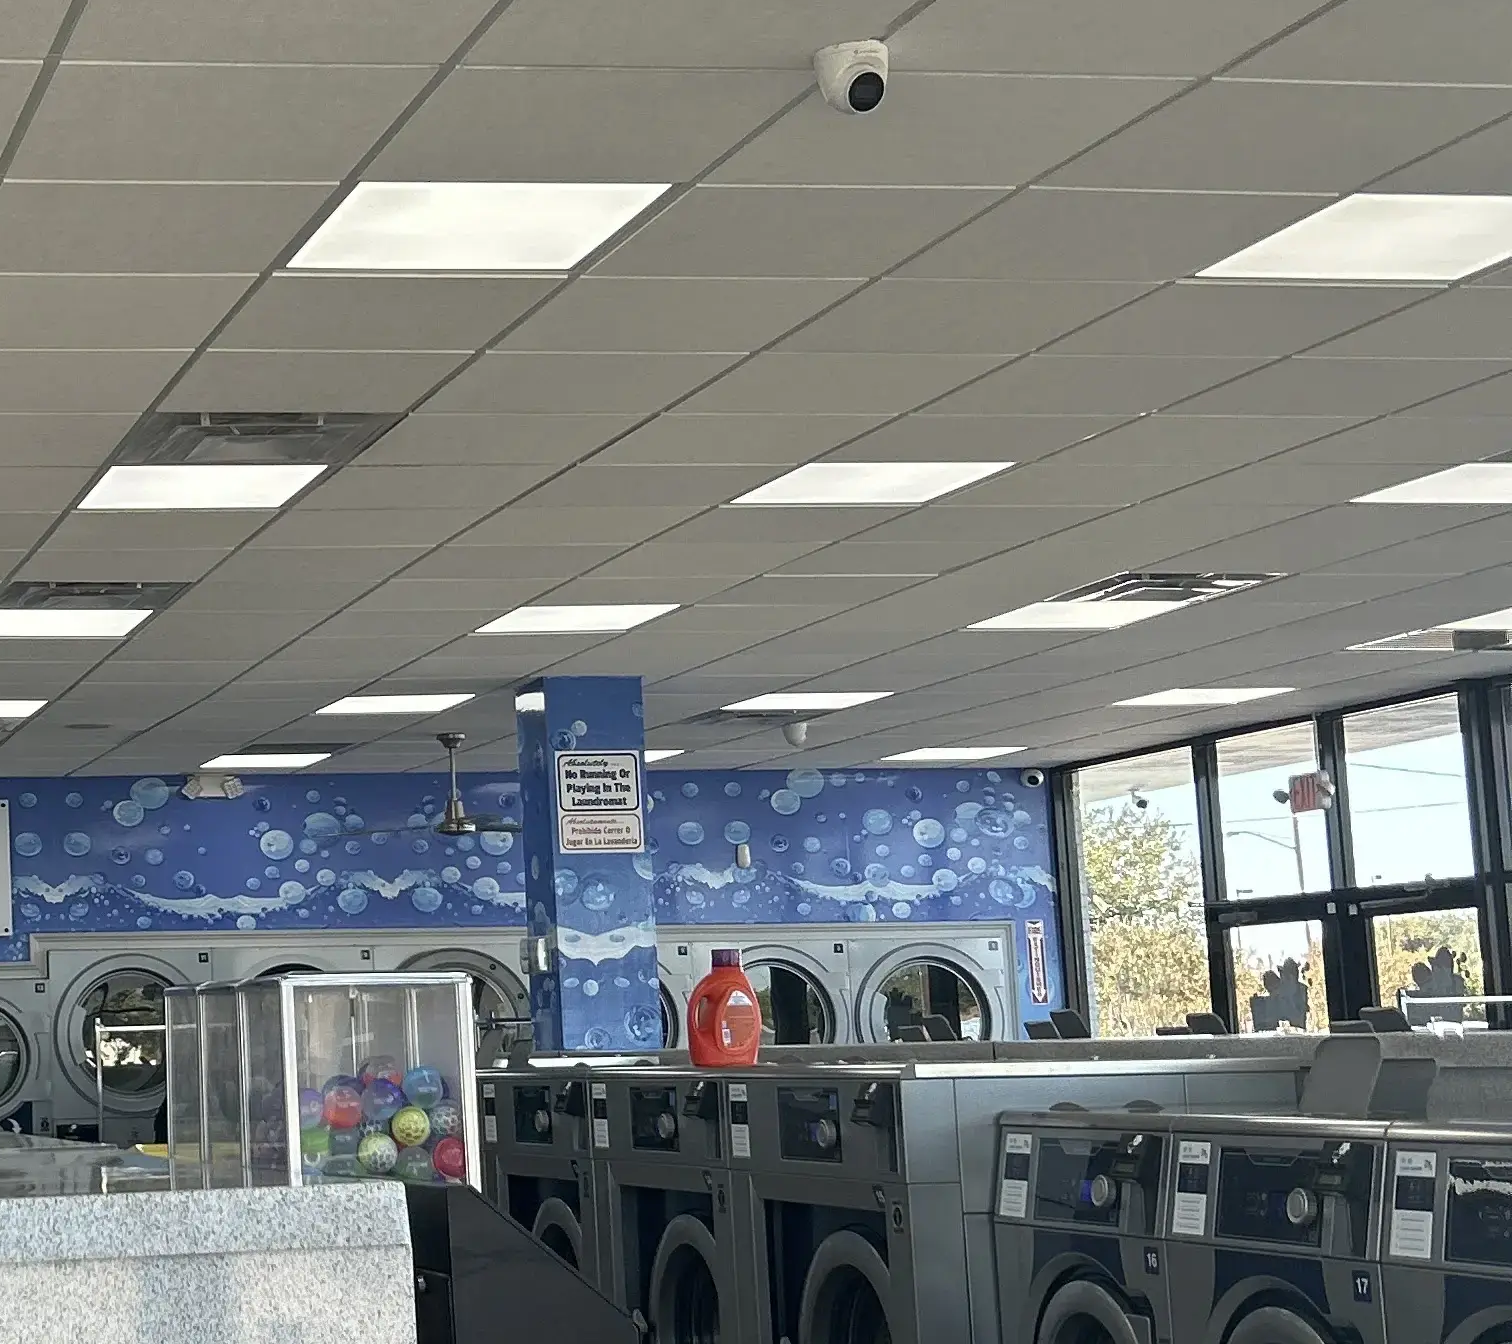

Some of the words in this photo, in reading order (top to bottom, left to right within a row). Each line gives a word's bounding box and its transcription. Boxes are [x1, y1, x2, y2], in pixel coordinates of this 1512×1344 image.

[565, 769, 578, 780] No
[580, 768, 618, 781] Running
[619, 768, 631, 779] Or
[566, 782, 601, 795] Playing
[603, 782, 613, 793] In
[614, 782, 631, 793] The
[571, 796, 628, 807] Laundromat
[603, 826, 624, 834] Correr
[566, 837, 584, 847] Jugar
[1146, 1252, 1158, 1268] 16
[1355, 1276, 1369, 1295] 17
